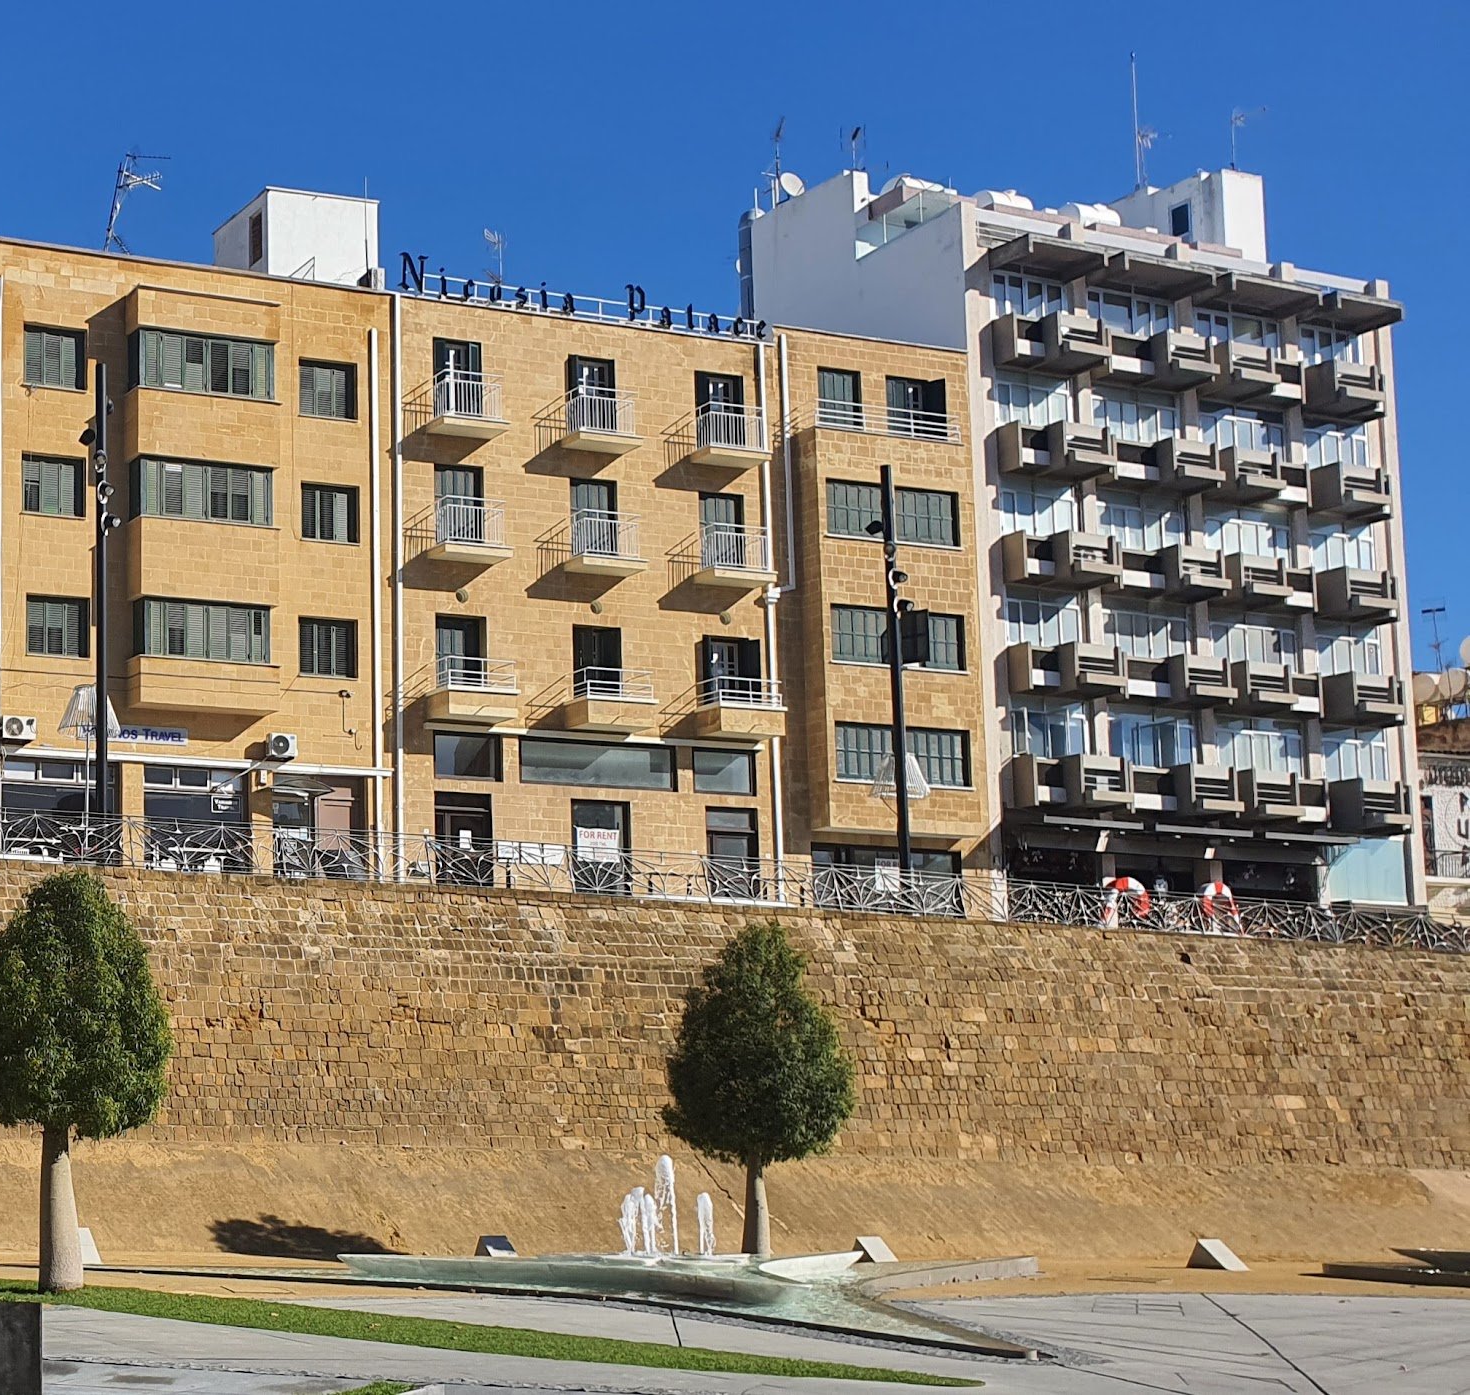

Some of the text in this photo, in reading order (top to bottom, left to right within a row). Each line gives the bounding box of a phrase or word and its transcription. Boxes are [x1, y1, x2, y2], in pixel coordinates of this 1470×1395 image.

[397, 251, 767, 340] Nicosia Palace
[579, 830, 617, 840] FOR RENT
